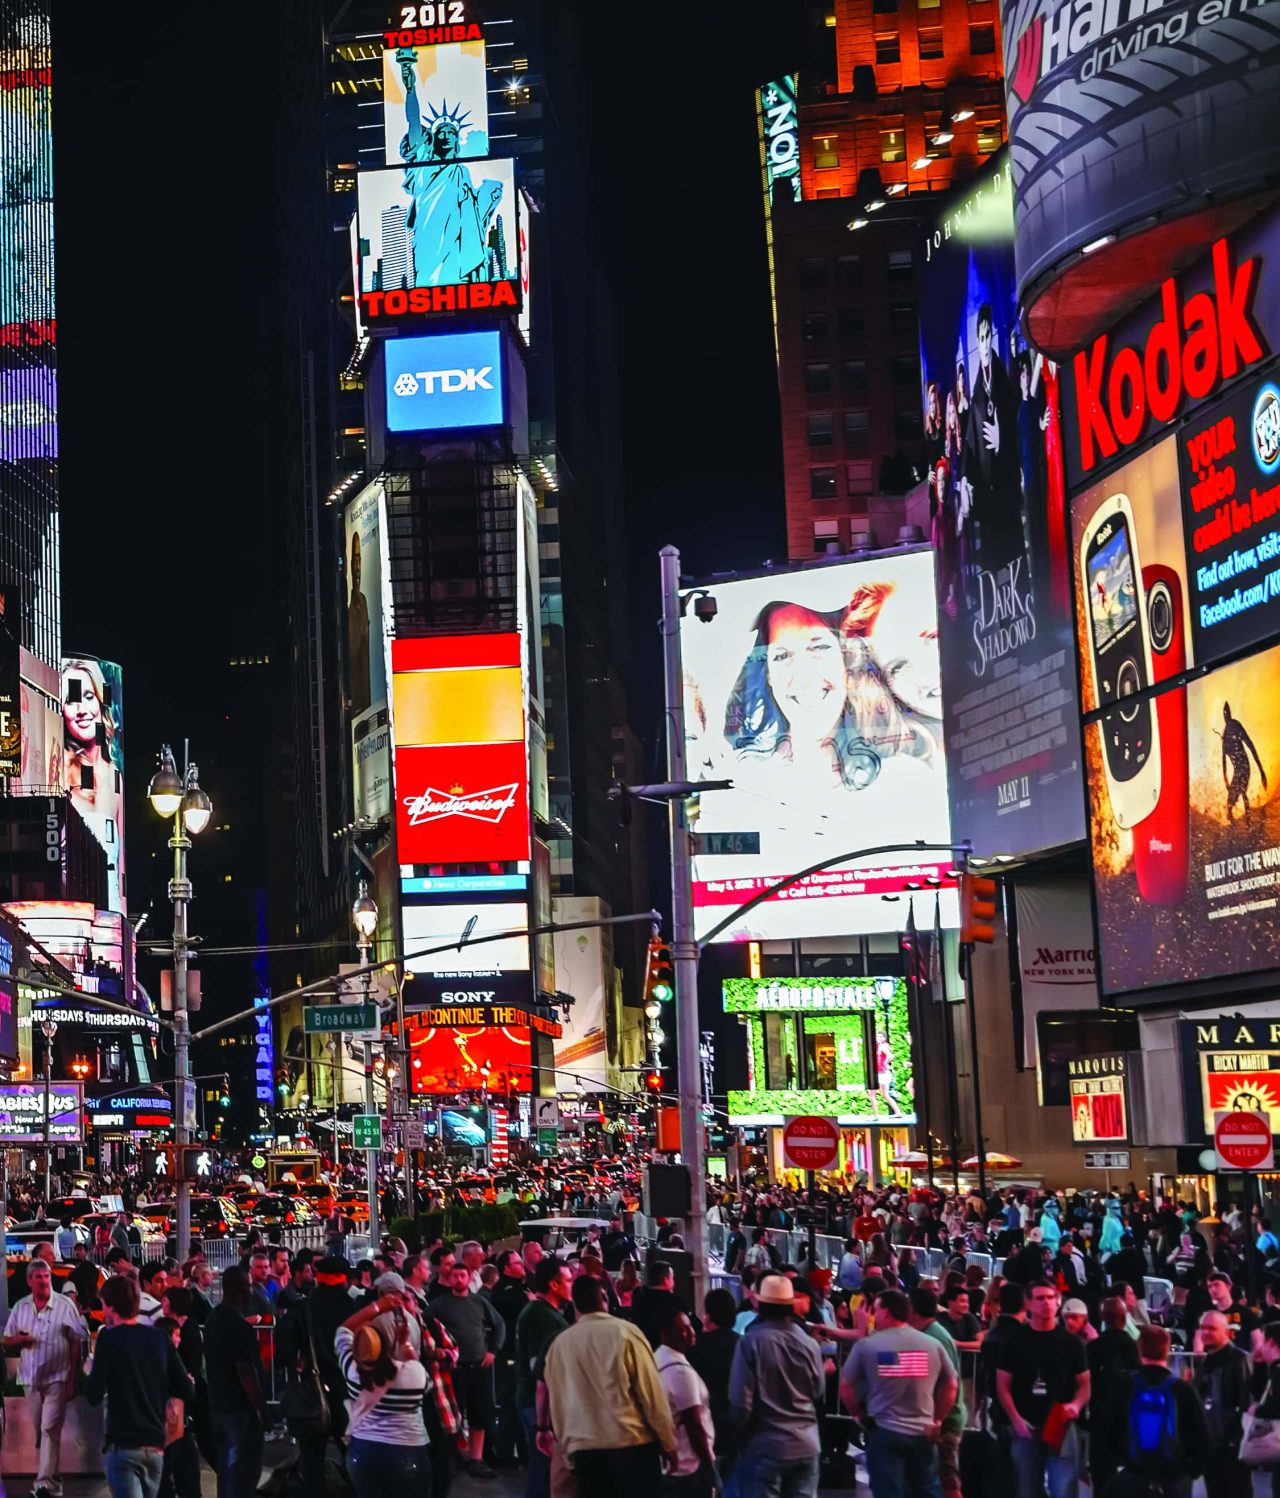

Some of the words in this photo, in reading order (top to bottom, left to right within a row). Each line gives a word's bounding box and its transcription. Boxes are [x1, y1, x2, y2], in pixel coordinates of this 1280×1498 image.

[401, 2, 465, 28] 2012
[384, 23, 482, 48] TOSHIBA
[1080, 10, 1189, 81] driving
[926, 190, 983, 261] JOHNNY
[362, 280, 517, 317] TOSHIBA
[1073, 238, 1265, 472] Kodak
[414, 366, 494, 394] TDK
[1186, 415, 1237, 473] YOUR
[1189, 465, 1236, 513] video
[1193, 503, 1233, 553] could
[1230, 499, 1252, 533] be
[1197, 561, 1219, 592] Find
[1218, 556, 1234, 582] out
[977, 556, 1023, 629] DARK
[973, 593, 1037, 678] SHADOWS
[997, 779, 1018, 806] MAY
[403, 795, 516, 816] Budweiser
[46, 799, 59, 862] 1500
[727, 837, 742, 851] 46
[1205, 861, 1226, 882] BUILT
[1227, 856, 1244, 876] FOR
[1243, 852, 1262, 872] THE
[433, 880, 455, 888] News
[457, 879, 506, 889] Corporation
[707, 882, 724, 892] May
[811, 873, 842, 884] Donate
[788, 886, 805, 898] Call
[457, 971, 473, 980] Sony
[1024, 968, 1045, 976] NEW
[1048, 968, 1074, 976] YORK
[441, 991, 496, 1003] SONY
[314, 1012, 367, 1027] Broadway
[429, 1008, 485, 1025] CONTINUE
[254, 997, 272, 1099] NYGARD
[1068, 1057, 1124, 1075] MARQUIS
[1213, 1055, 1238, 1072] RICKY
[1238, 1054, 1269, 1071] MARTIN
[14, 1115, 31, 1124] Now
[1224, 1123, 1238, 1132] DO
[1241, 1122, 1260, 1132] NOT
[49, 1124, 76, 1135] Square
[792, 1126, 806, 1135] DO
[809, 1126, 828, 1135] NOT
[795, 1149, 827, 1159] ENTER
[1229, 1148, 1260, 1157] ENTER
